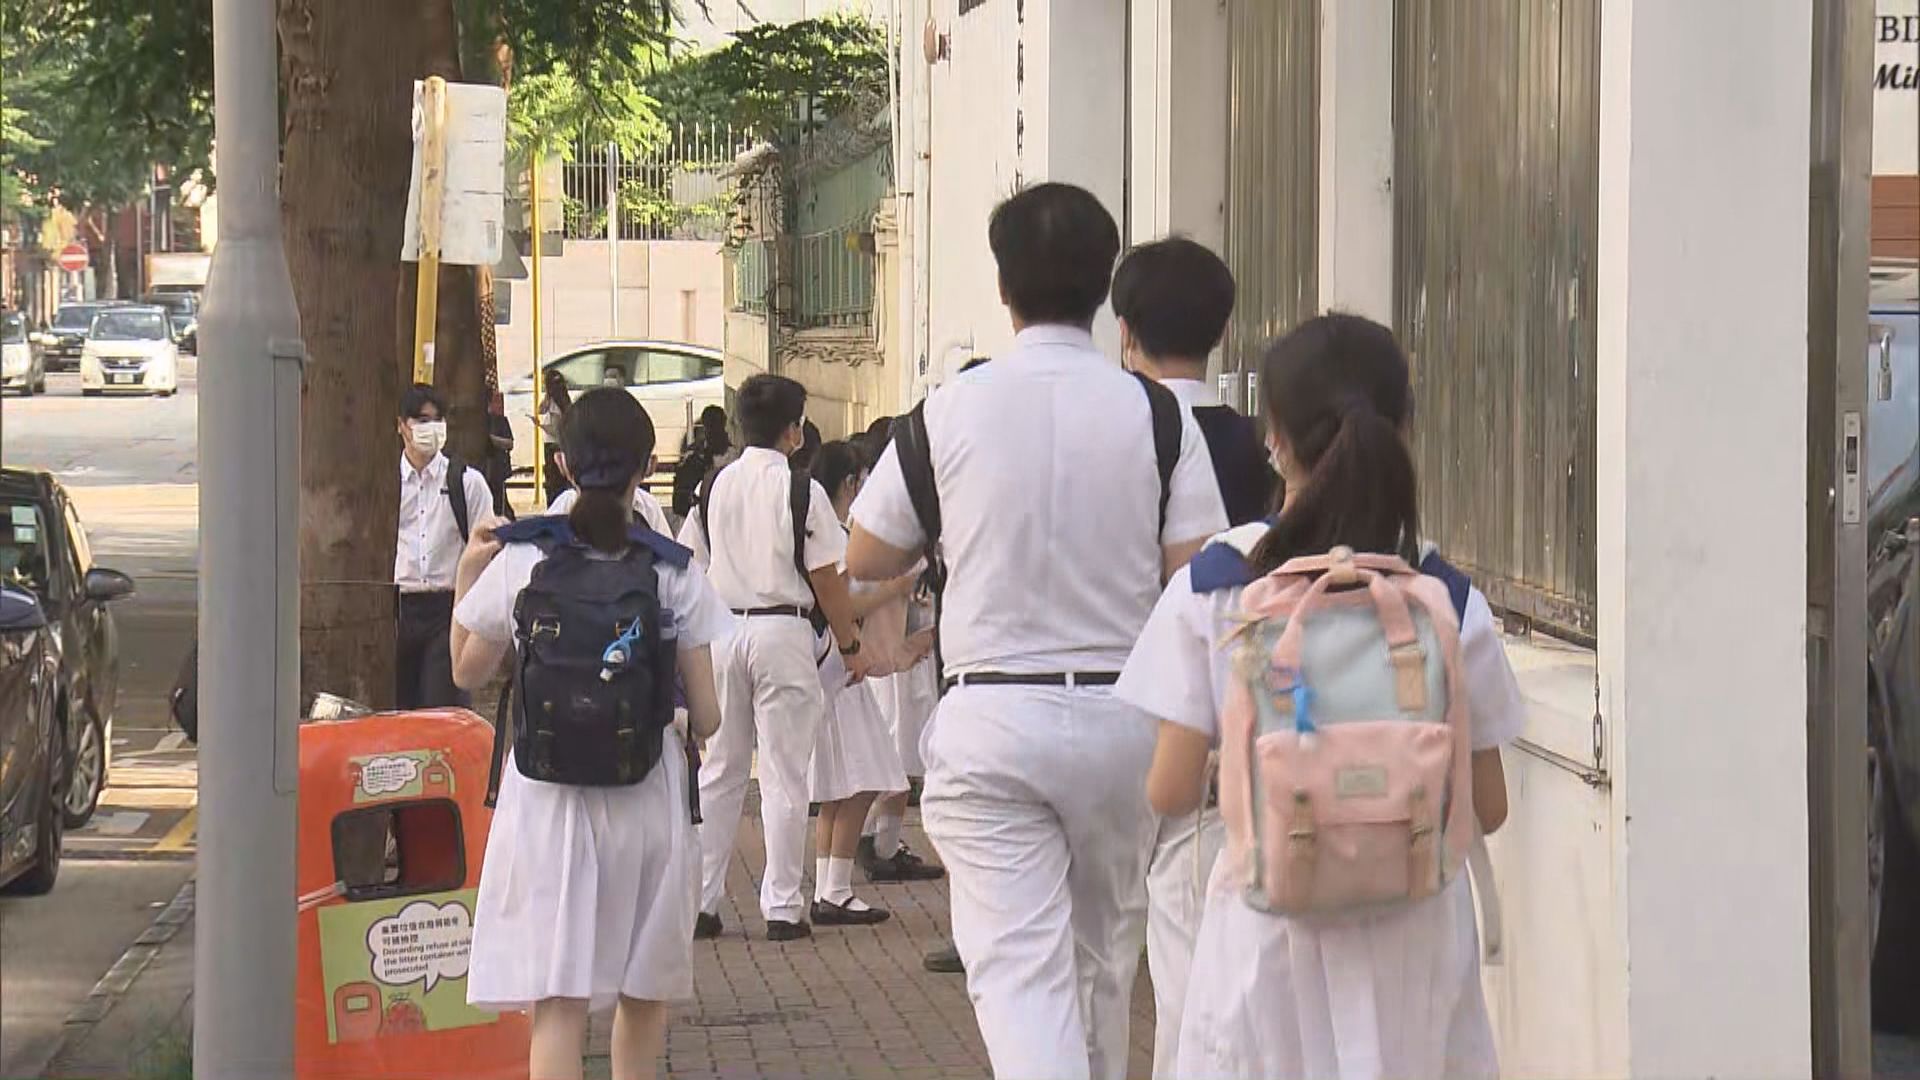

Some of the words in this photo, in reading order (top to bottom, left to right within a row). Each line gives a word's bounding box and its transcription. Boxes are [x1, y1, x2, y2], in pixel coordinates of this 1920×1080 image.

[383, 944, 424, 956] Discarding
[425, 941, 450, 950] refuse
[384, 957, 397, 966] the
[399, 955, 418, 963] litter
[420, 951, 455, 961] container
[384, 963, 428, 977] prosecuted
